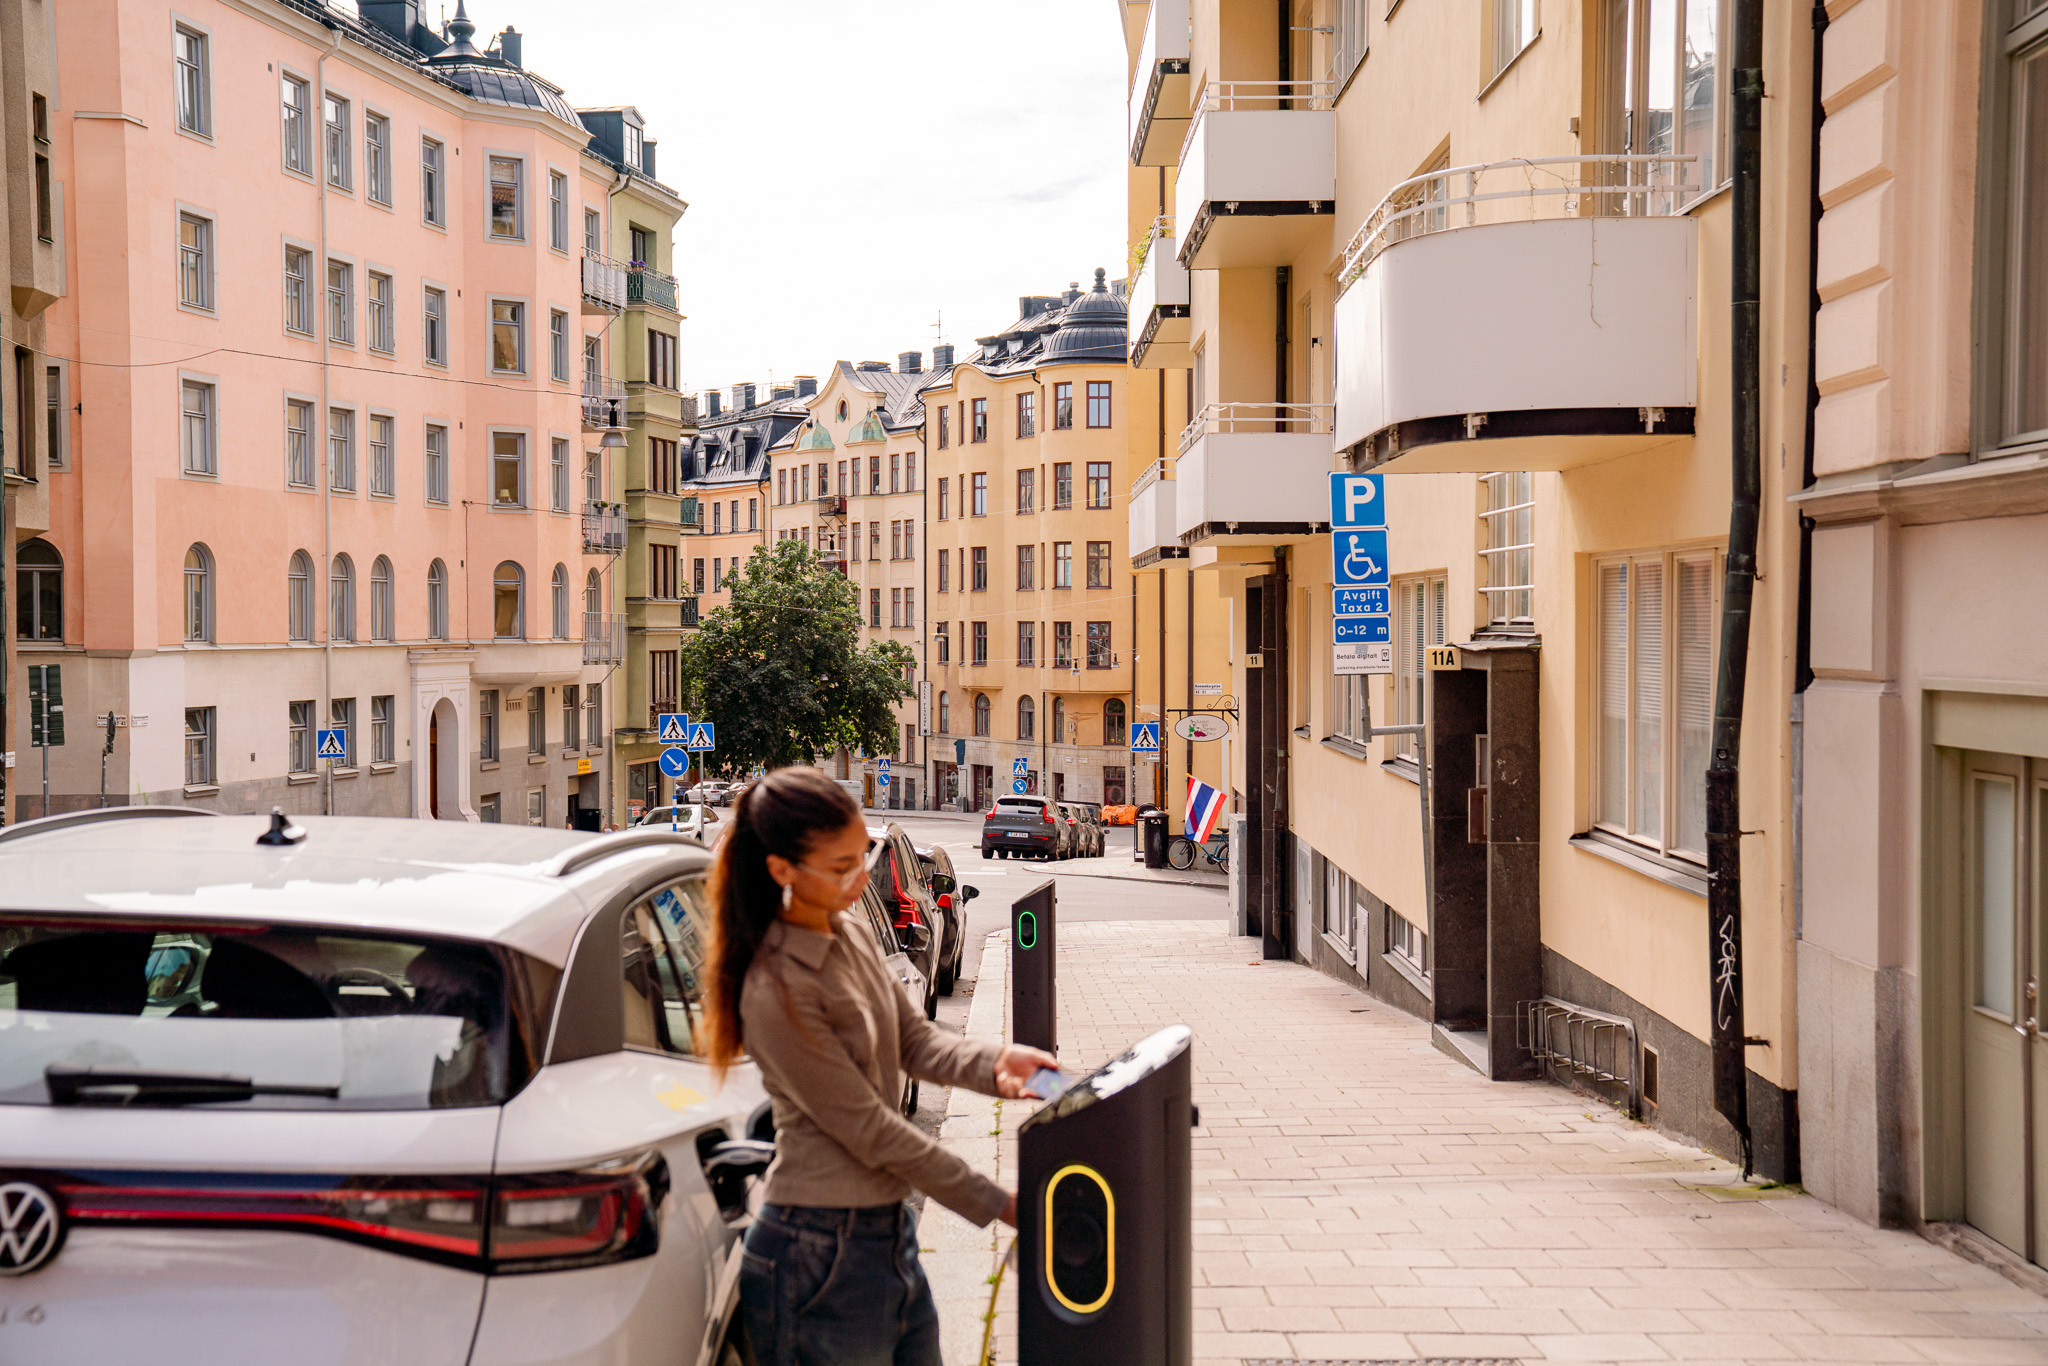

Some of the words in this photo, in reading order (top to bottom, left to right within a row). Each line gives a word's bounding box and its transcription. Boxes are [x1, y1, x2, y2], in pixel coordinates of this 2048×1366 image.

[1344, 477, 1376, 522] P
[1343, 590, 1380, 602] Avgift
[1341, 603, 1371, 613] Taxa
[1375, 602, 1383, 612] 2
[1337, 625, 1367, 636] 0-12
[1376, 626, 1387, 635] m
[1250, 656, 1258, 665] 11
[1432, 650, 1455, 666] 11A
